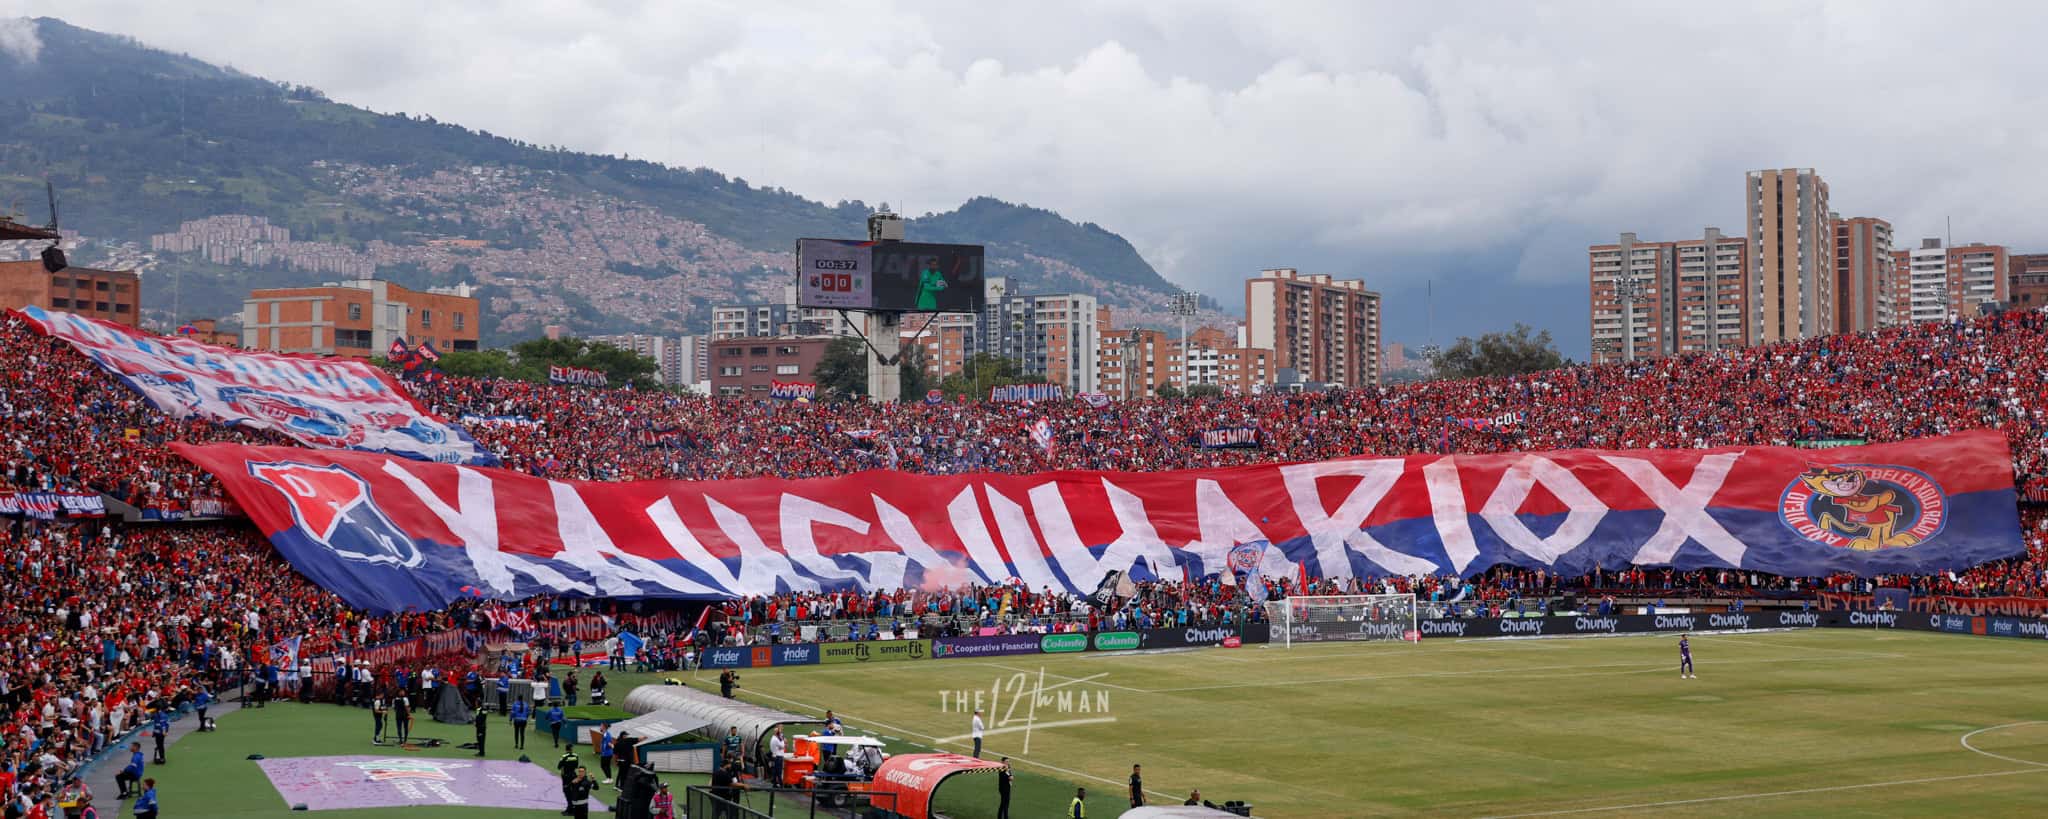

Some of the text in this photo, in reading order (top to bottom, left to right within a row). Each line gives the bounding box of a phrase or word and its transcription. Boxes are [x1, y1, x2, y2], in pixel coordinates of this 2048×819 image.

[818, 260, 855, 269] 00:37
[823, 277, 848, 288] 0 0
[991, 384, 1063, 402] ANDALUXIA
[1783, 491, 1809, 525] VIEJO
[1871, 469, 1941, 536] BELEN XOLO ROJO
[1500, 617, 1544, 634] Chunky
[1576, 616, 1618, 633] Chunky
[1655, 615, 1696, 631] Chunky
[1709, 613, 1750, 630] Chunky
[1779, 611, 1819, 628] Chunky
[1850, 611, 1897, 627] Chunky
[1421, 619, 1466, 637] Chunky
[954, 643, 1000, 653] Cooperativa
[1001, 641, 1039, 651] Financiera
[1043, 636, 1086, 649] Colanta
[1097, 633, 1138, 647] Colanta
[826, 647, 854, 656] smart
[880, 645, 907, 654] smart
